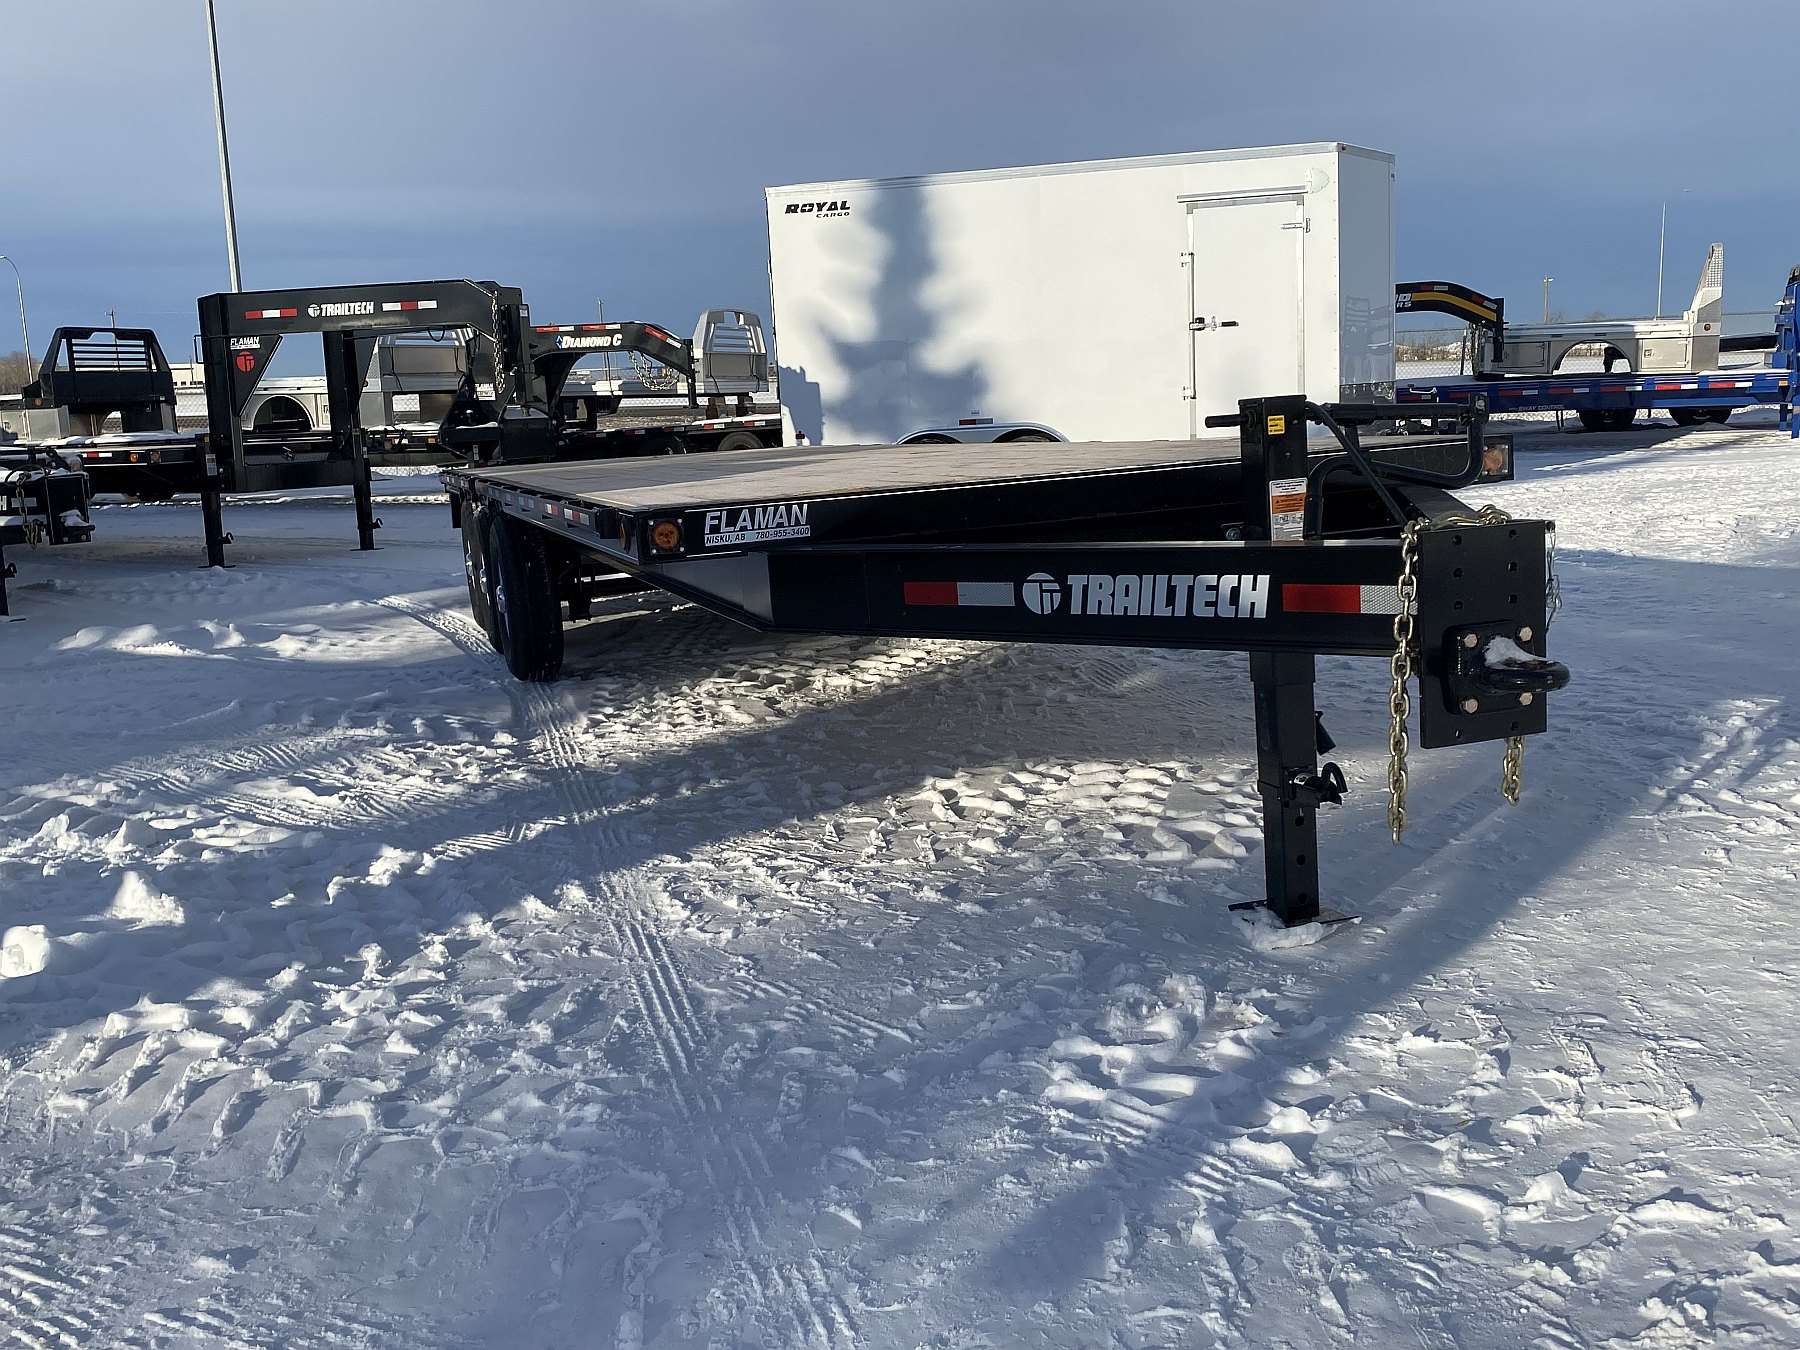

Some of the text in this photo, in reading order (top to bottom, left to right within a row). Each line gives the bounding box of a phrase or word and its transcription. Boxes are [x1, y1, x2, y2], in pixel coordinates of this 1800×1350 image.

[785, 200, 850, 214] ROYAL
[321, 301, 374, 317] TRAILTECH
[230, 336, 260, 346] FLAMAN
[562, 334, 623, 349] DIAMOND C
[704, 503, 808, 534] FLAMAN
[706, 527, 810, 544] NISKU, AB 780-955-3400
[1067, 574, 1271, 619] TRAILTECH
